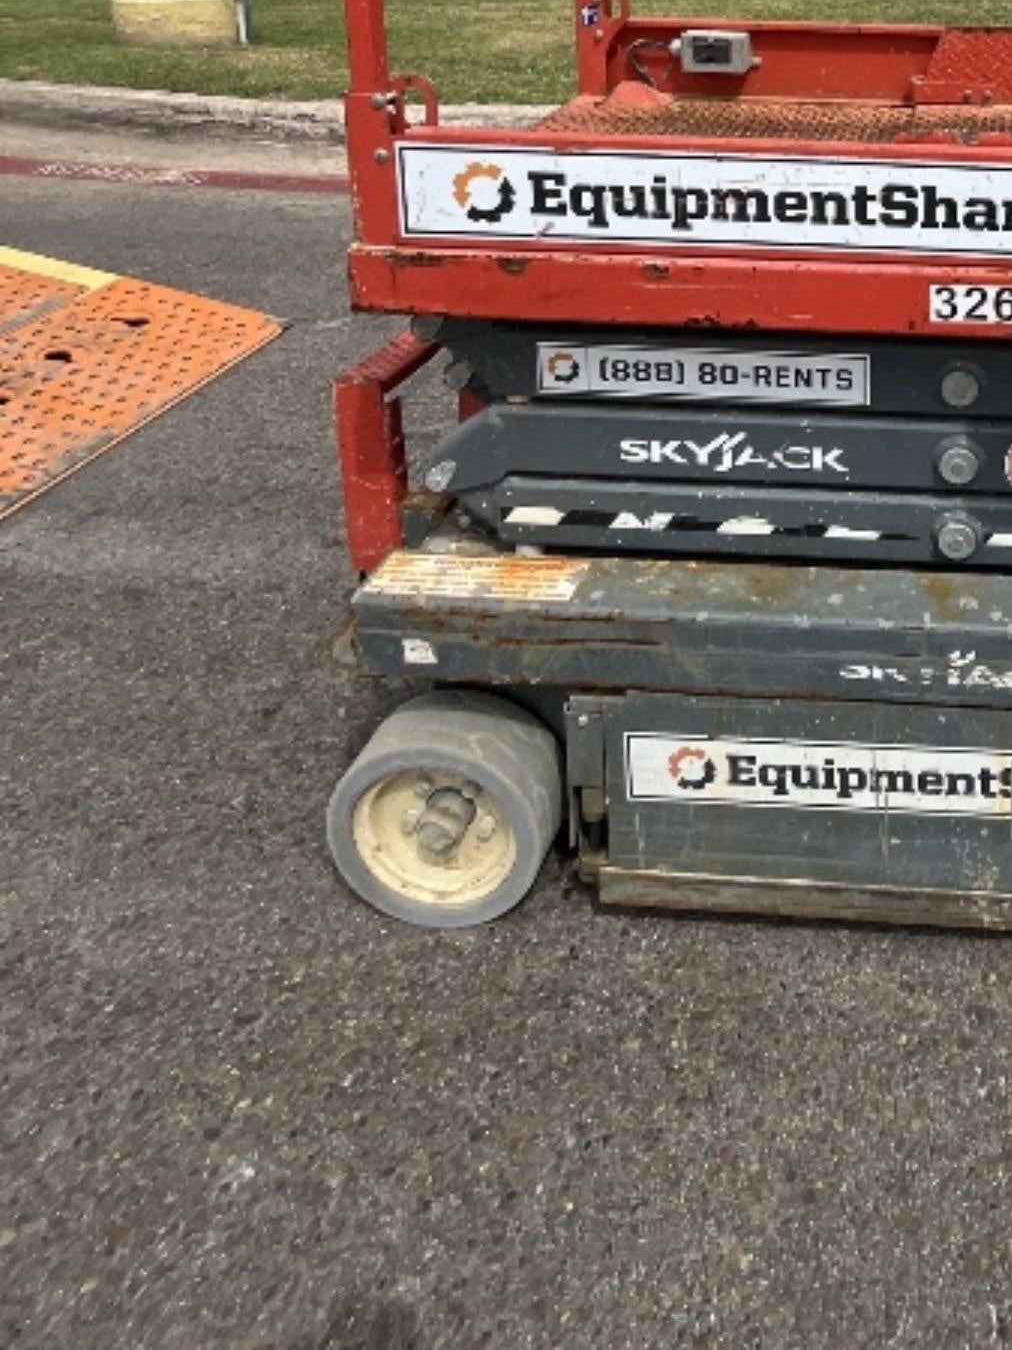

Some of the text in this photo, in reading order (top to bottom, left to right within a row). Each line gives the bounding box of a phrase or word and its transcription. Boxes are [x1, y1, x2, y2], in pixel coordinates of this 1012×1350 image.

[600, 357, 853, 391] (888) 80-RENTS
[620, 431, 849, 472] SKYJACK
